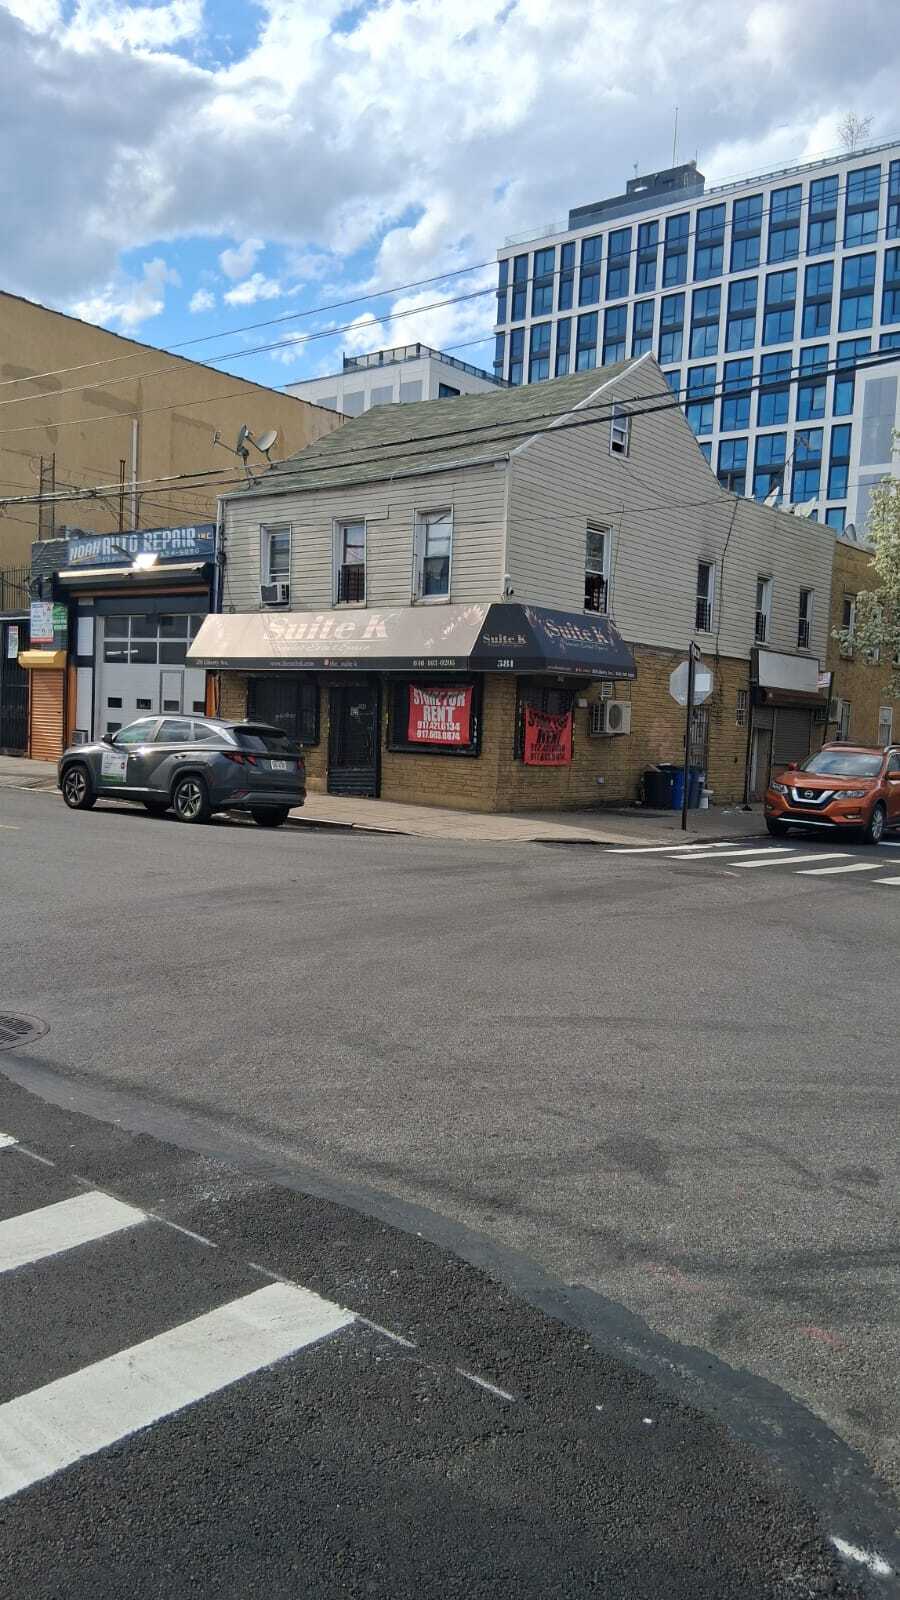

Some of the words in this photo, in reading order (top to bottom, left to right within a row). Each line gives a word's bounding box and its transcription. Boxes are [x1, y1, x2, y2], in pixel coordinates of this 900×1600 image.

[102, 534, 138, 555] AUTO
[143, 527, 196, 552] REPAIR
[268, 616, 356, 640] Suite
[361, 614, 391, 639] K
[482, 633, 512, 644] Suite
[516, 634, 528, 645] K
[546, 619, 592, 641] Suite
[592, 626, 609, 644] K
[423, 705, 456, 722] RENT
